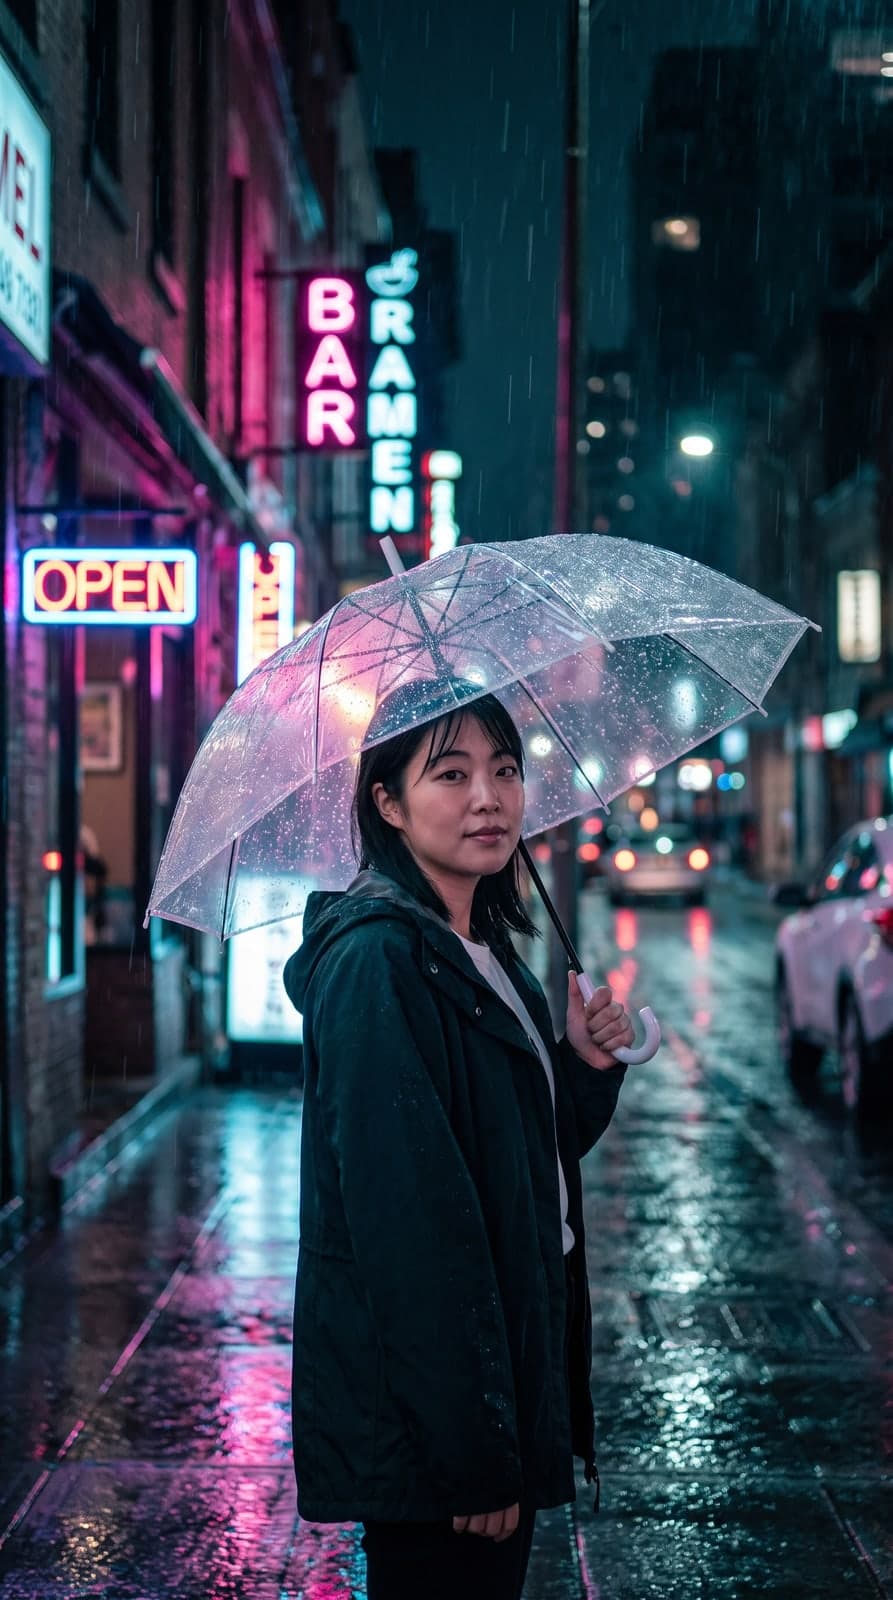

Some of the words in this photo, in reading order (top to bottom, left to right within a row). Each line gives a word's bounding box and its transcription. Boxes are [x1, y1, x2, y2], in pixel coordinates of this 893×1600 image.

[305, 277, 357, 446] BAR
[367, 299, 416, 533] RAMEN
[34, 559, 185, 613] OPEN
[253, 553, 281, 664] OPE
